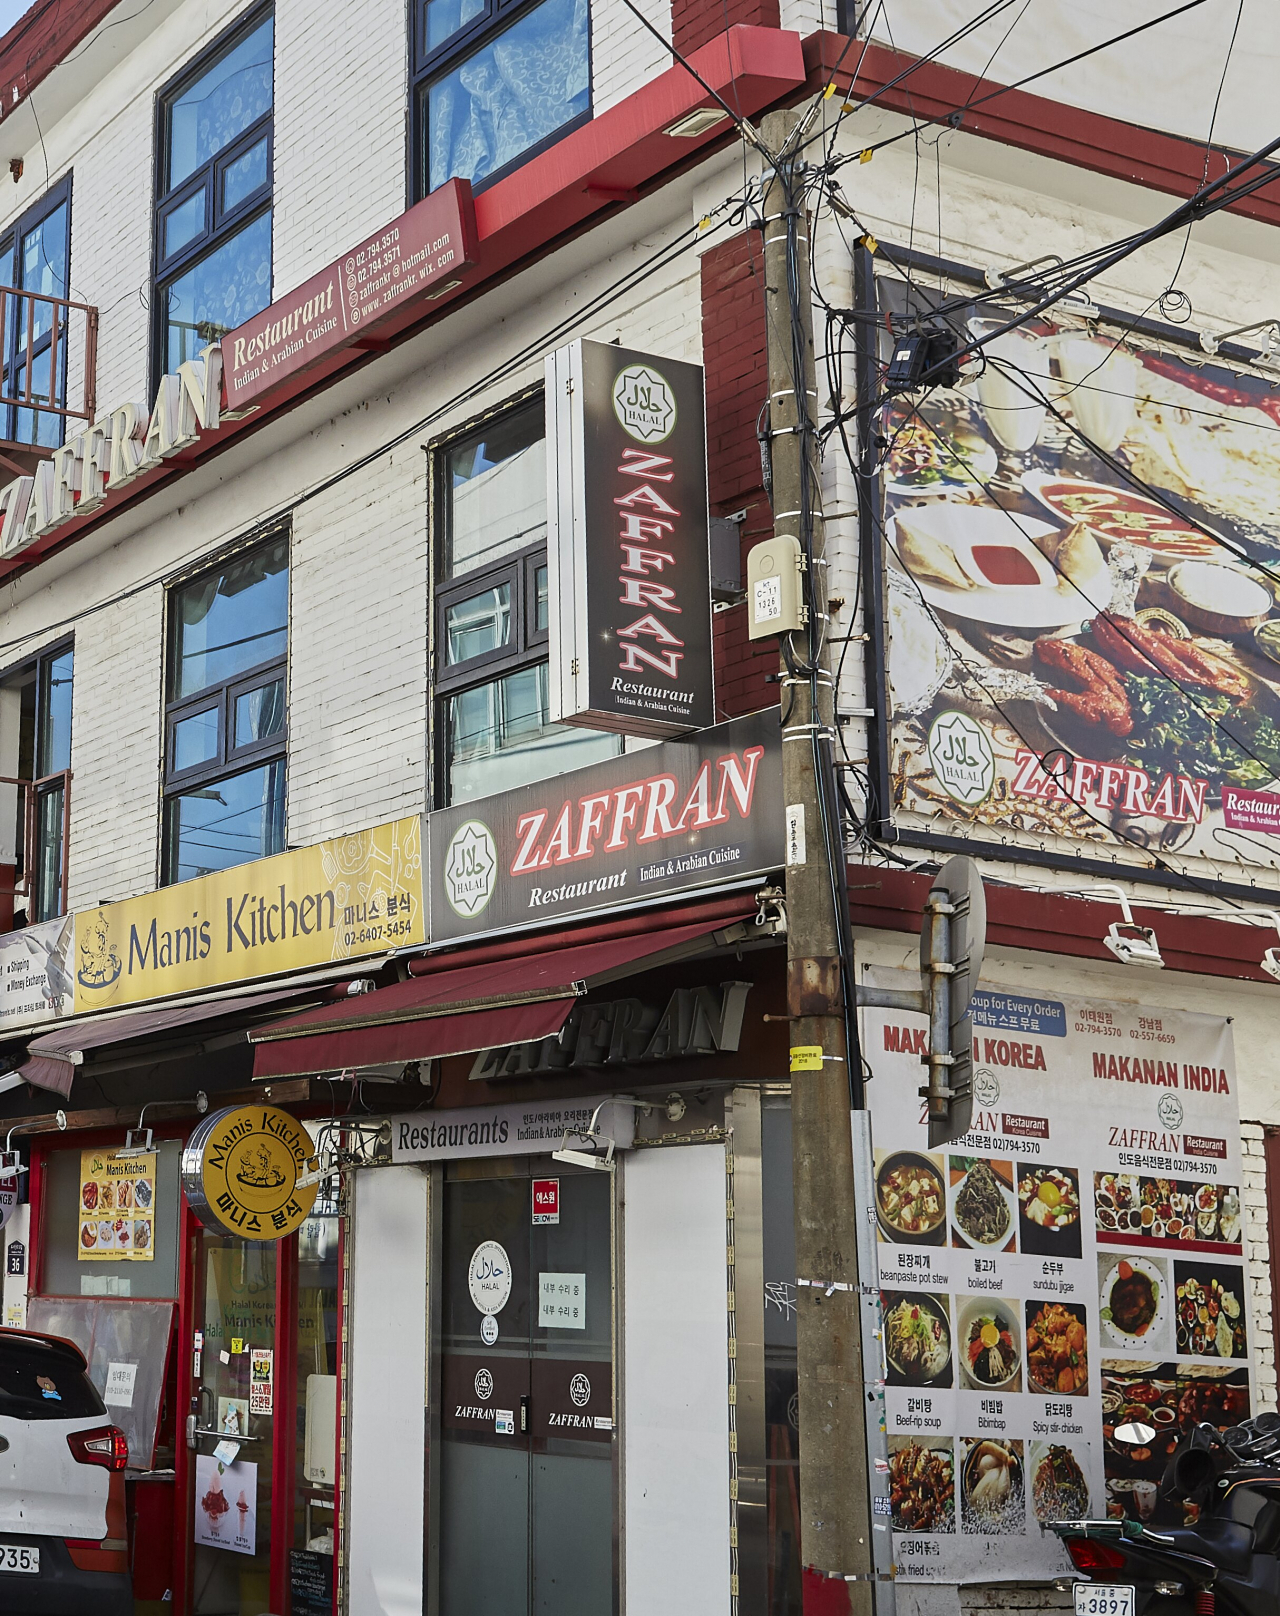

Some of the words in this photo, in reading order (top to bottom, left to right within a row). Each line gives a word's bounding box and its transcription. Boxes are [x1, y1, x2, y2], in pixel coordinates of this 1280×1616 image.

[355, 226, 401, 266] 02.794.3570
[402, 232, 450, 272] hotmail.com
[357, 245, 401, 284] 02.794.3571
[437, 249, 455, 271] com
[232, 279, 335, 372] Restaurant
[233, 365, 260, 391] Indian
[261, 358, 270, 373] &
[271, 335, 304, 368] Arabian
[305, 315, 338, 347] Cuisine
[626, 383, 663, 416] حلال
[628, 410, 662, 426] HALAL
[613, 447, 684, 679] ZAFFRAN
[610, 676, 694, 704] Restaurant
[615, 695, 637, 707] Indian
[644, 699, 668, 713] Arabian
[668, 703, 691, 716] Cuisine
[941, 733, 980, 766] حلال
[946, 767, 980, 783] HALAL
[1012, 747, 1209, 825] ZAFFRAN
[511, 747, 764, 875] ZAFFRAN
[1226, 793, 1280, 815] Restaur
[455, 844, 486, 878] حلال
[456, 878, 485, 895] HALAL
[527, 869, 628, 908] Restaurant
[640, 864, 665, 882] Indian
[666, 863, 675, 877] &
[676, 852, 708, 873] Arabian
[709, 846, 741, 865] Cuisine
[345, 904, 379, 927] 마니스
[386, 892, 412, 917] 분식
[128, 912, 211, 975] Manis
[226, 884, 335, 954] Kitchen
[344, 920, 412, 947] 02-6407-5454
[971, 997, 989, 1010] oup
[991, 998, 1006, 1010] for
[1007, 999, 1033, 1016] Every
[1034, 1003, 1061, 1018] Order
[999, 1013, 1018, 1028] 스프
[1020, 1016, 1041, 1031] 무료
[1080, 1009, 1113, 1025] 이태원점
[1138, 1016, 1163, 1031] 강남점
[1074, 1022, 1122, 1038] 02-794-3570
[1130, 1030, 1176, 1044] 02-557-6659
[984, 1037, 1047, 1071] KOREA
[1092, 1052, 1179, 1089] MAKANAN
[1183, 1064, 1230, 1095] INDIA
[1005, 1114, 1045, 1130] Restaurant
[207, 1118, 253, 1170] Manis
[397, 1115, 510, 1152] Restaurants
[947, 1133, 991, 1150] 음식전문점
[993, 1138, 1041, 1154] 02)794-3570
[1108, 1126, 1181, 1154] ZAFFRAN
[1186, 1136, 1224, 1151] Restaurant
[106, 1163, 124, 1176] Manis
[124, 1161, 147, 1175] Kitchen
[1118, 1152, 1172, 1170] 인도음식전문점
[1173, 1159, 1218, 1175] 02)794-3570
[536, 1191, 556, 1205] 에스원
[215, 1191, 262, 1233] 마니스
[271, 1198, 303, 1231] 분식
[11, 1258, 20, 1272] 36
[476, 1256, 504, 1280] حلال
[974, 1259, 996, 1273] 불고기
[1042, 1261, 1064, 1276] 순두부
[481, 1282, 500, 1291] HALAL
[880, 1269, 917, 1285] beanpaste
[919, 1273, 931, 1284] pot
[932, 1273, 948, 1284] stew
[989, 1279, 1003, 1290] beef
[543, 1283, 555, 1294] 내부
[558, 1284, 570, 1295] 수리
[573, 1285, 579, 1296] 중
[253, 1300, 276, 1309] Korea
[543, 1304, 555, 1315] 내부
[558, 1306, 570, 1317] 수리
[572, 1307, 579, 1318] 중
[224, 1315, 262, 1328] Manis
[455, 1405, 496, 1421] ZAFFRAN
[908, 1398, 932, 1413] 갈비탕
[981, 1400, 1003, 1415] 비빔밥
[548, 1413, 594, 1429] ZAFFRAN
[896, 1414, 922, 1429] Beef-rip
[924, 1418, 942, 1430] soup
[978, 1416, 1006, 1431] Bibimbap
[1033, 1421, 1049, 1436] Spicy
[1088, 1598, 1129, 1616] 3897
